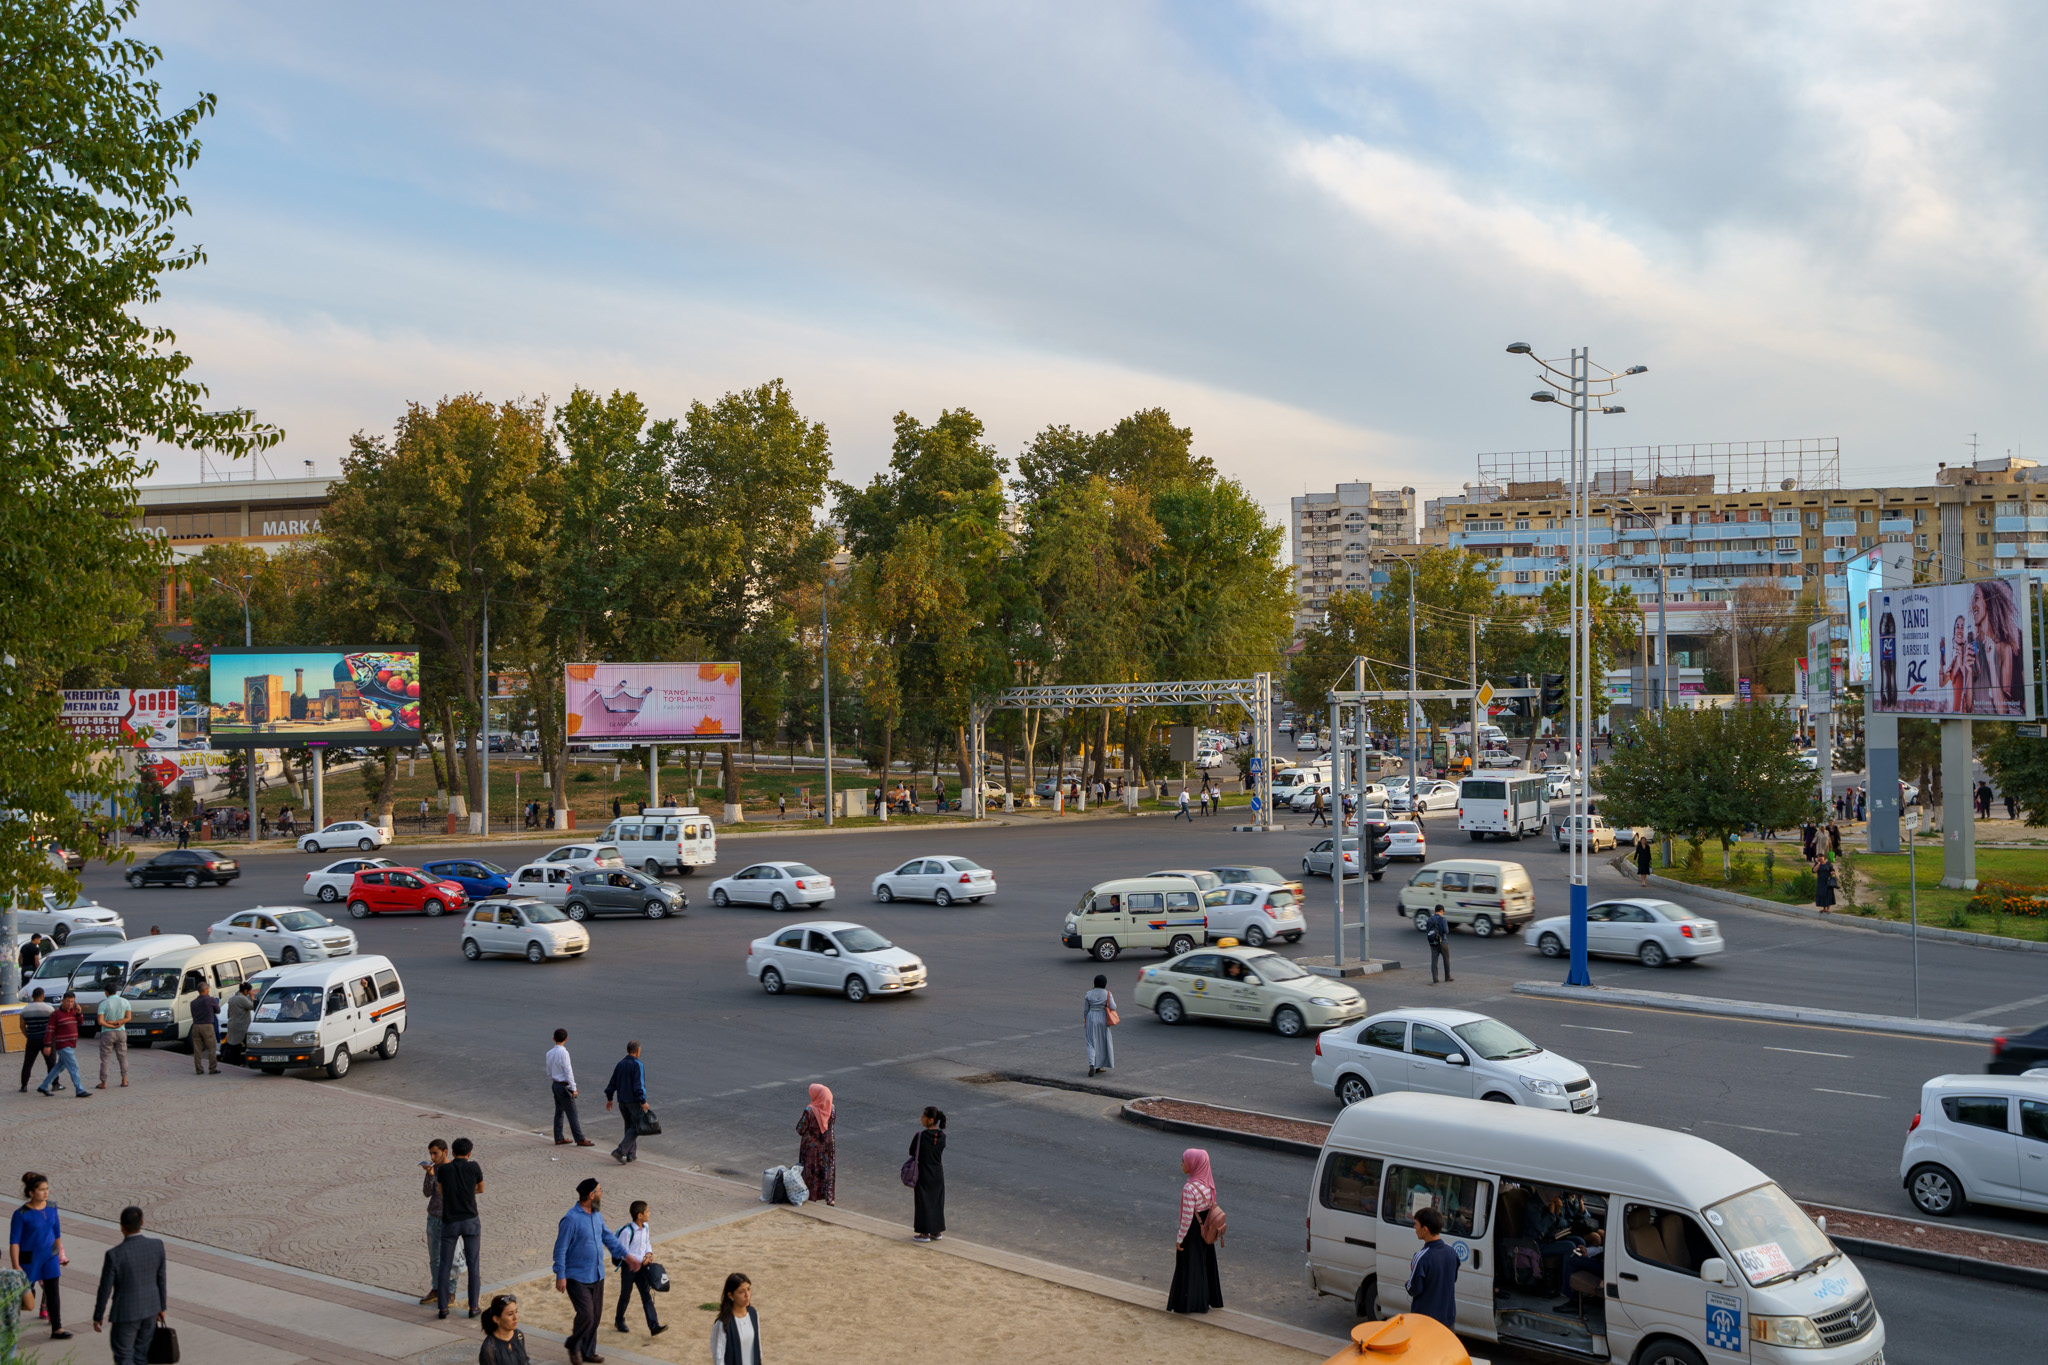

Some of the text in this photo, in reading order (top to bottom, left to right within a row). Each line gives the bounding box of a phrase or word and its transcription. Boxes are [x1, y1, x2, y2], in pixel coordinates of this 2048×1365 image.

[1901, 608, 1929, 628] YANGI
[64, 690, 120, 701] KREDITGA
[63, 702, 119, 711] METAN GAZ
[72, 717, 120, 725] 509-89-49
[1906, 815, 1917, 826] STOP
[1740, 1250, 1765, 1271] 466
